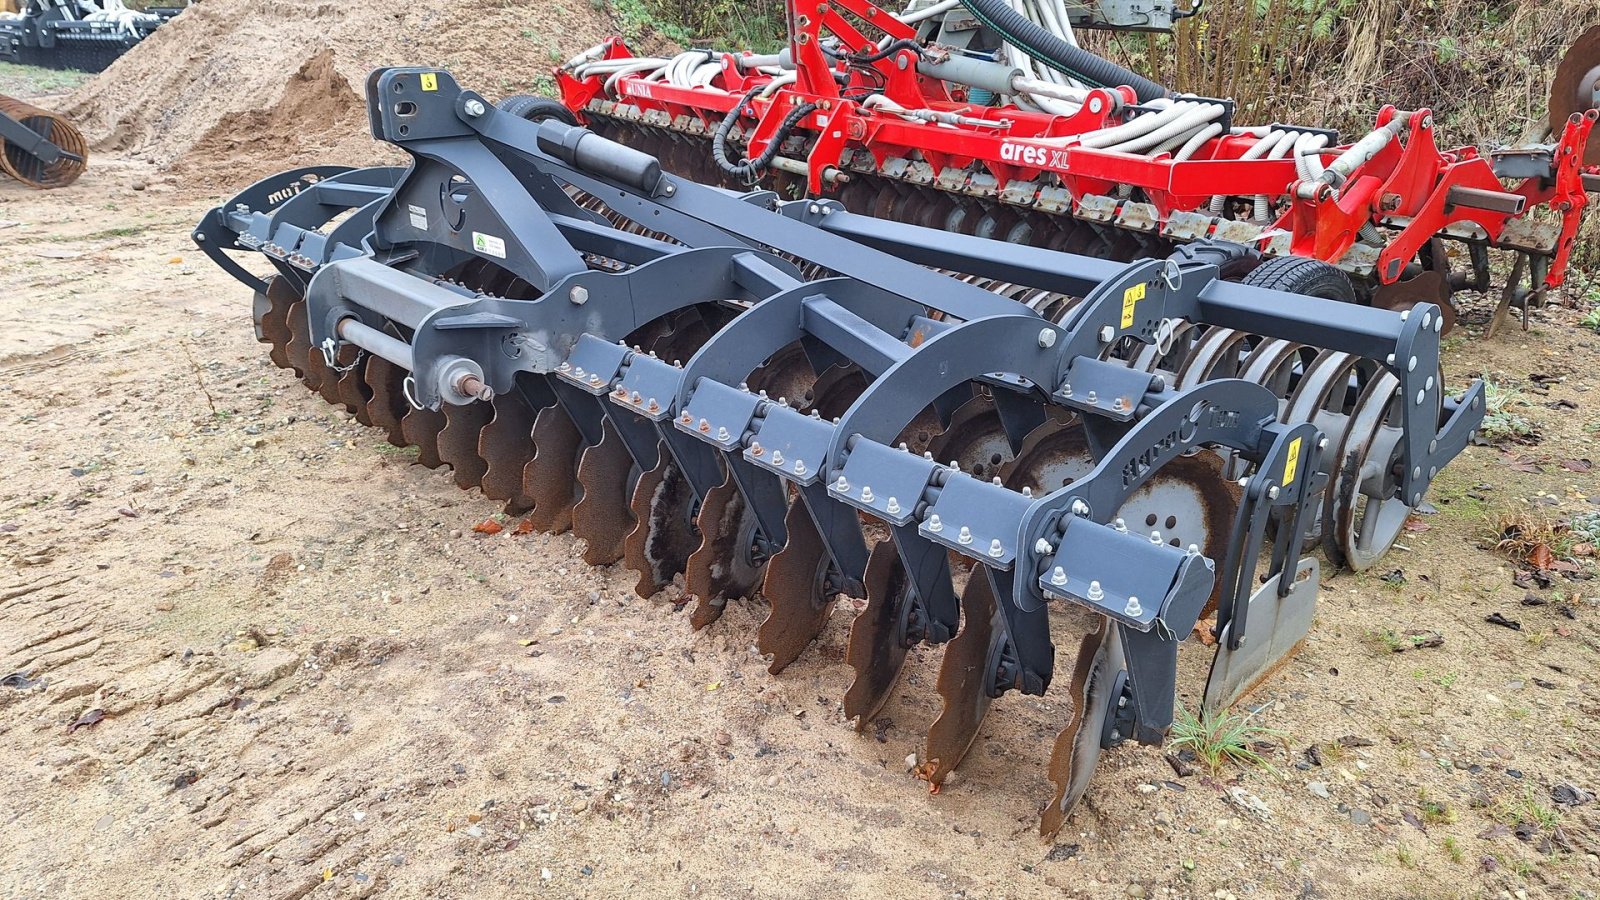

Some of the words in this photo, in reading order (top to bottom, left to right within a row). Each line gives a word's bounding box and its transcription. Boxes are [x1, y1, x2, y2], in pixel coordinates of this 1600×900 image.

[630, 83, 653, 99] UNIA
[1000, 142, 1047, 166] ares
[1049, 150, 1070, 170] XL
